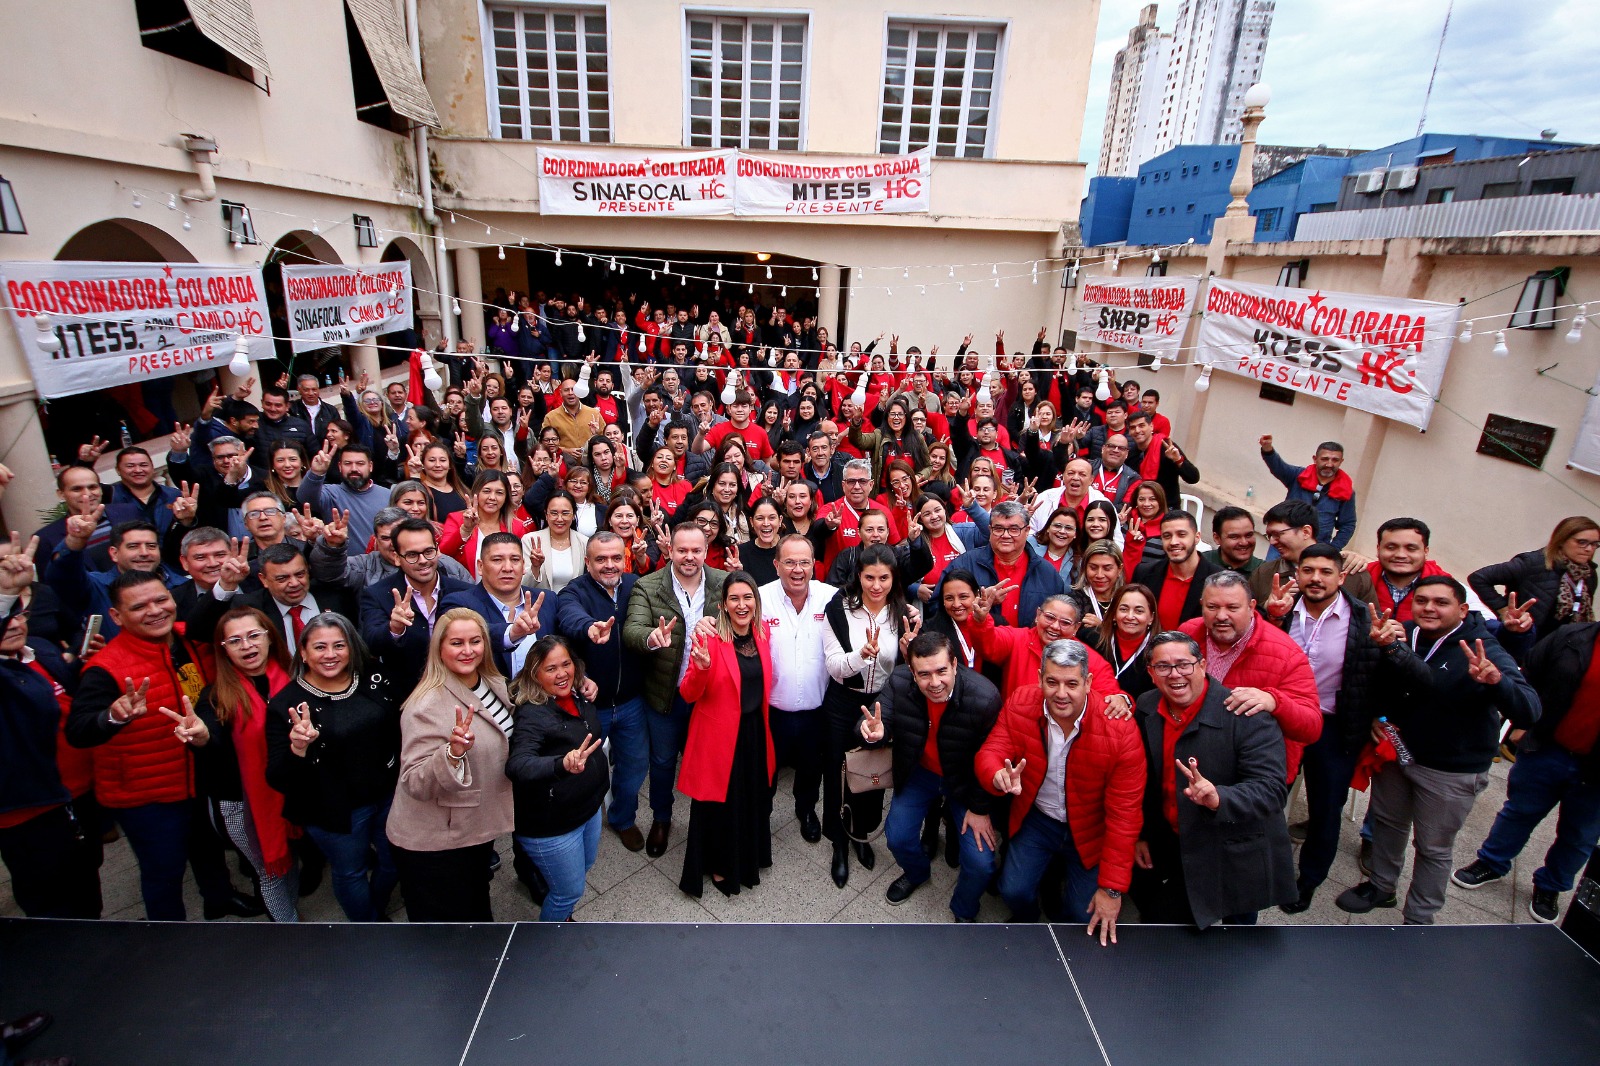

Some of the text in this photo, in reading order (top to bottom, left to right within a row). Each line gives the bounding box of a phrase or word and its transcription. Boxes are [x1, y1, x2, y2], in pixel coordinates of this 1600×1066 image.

[543, 157, 726, 178] COORDINADORA COLORADA
[737, 157, 921, 179] COORDINADORA COLORADA
[572, 181, 726, 201] SINAFOCAL HC
[792, 179, 922, 201] MTESS HC
[598, 200, 675, 213] PRESENTE
[785, 200, 884, 214] PRESENTE
[7, 275, 258, 318] COORDINADORA COLORADA
[287, 271, 405, 301] COORDINADORA COLORADA
[1083, 283, 1186, 311] COORDINADORA COLORADA
[176, 309, 236, 334] CAMILO
[237, 310, 264, 335] HC
[294, 298, 404, 332] SINAFOCAL CAMILO HC
[1097, 306, 1178, 336] SNPP HC
[1207, 286, 1426, 353] COORDINADORA COLORADA
[189, 332, 230, 346] INTENDENTE
[1096, 329, 1144, 348] PRESENTE
[128, 345, 215, 375] PRESENTE
[1356, 351, 1416, 395] HC
